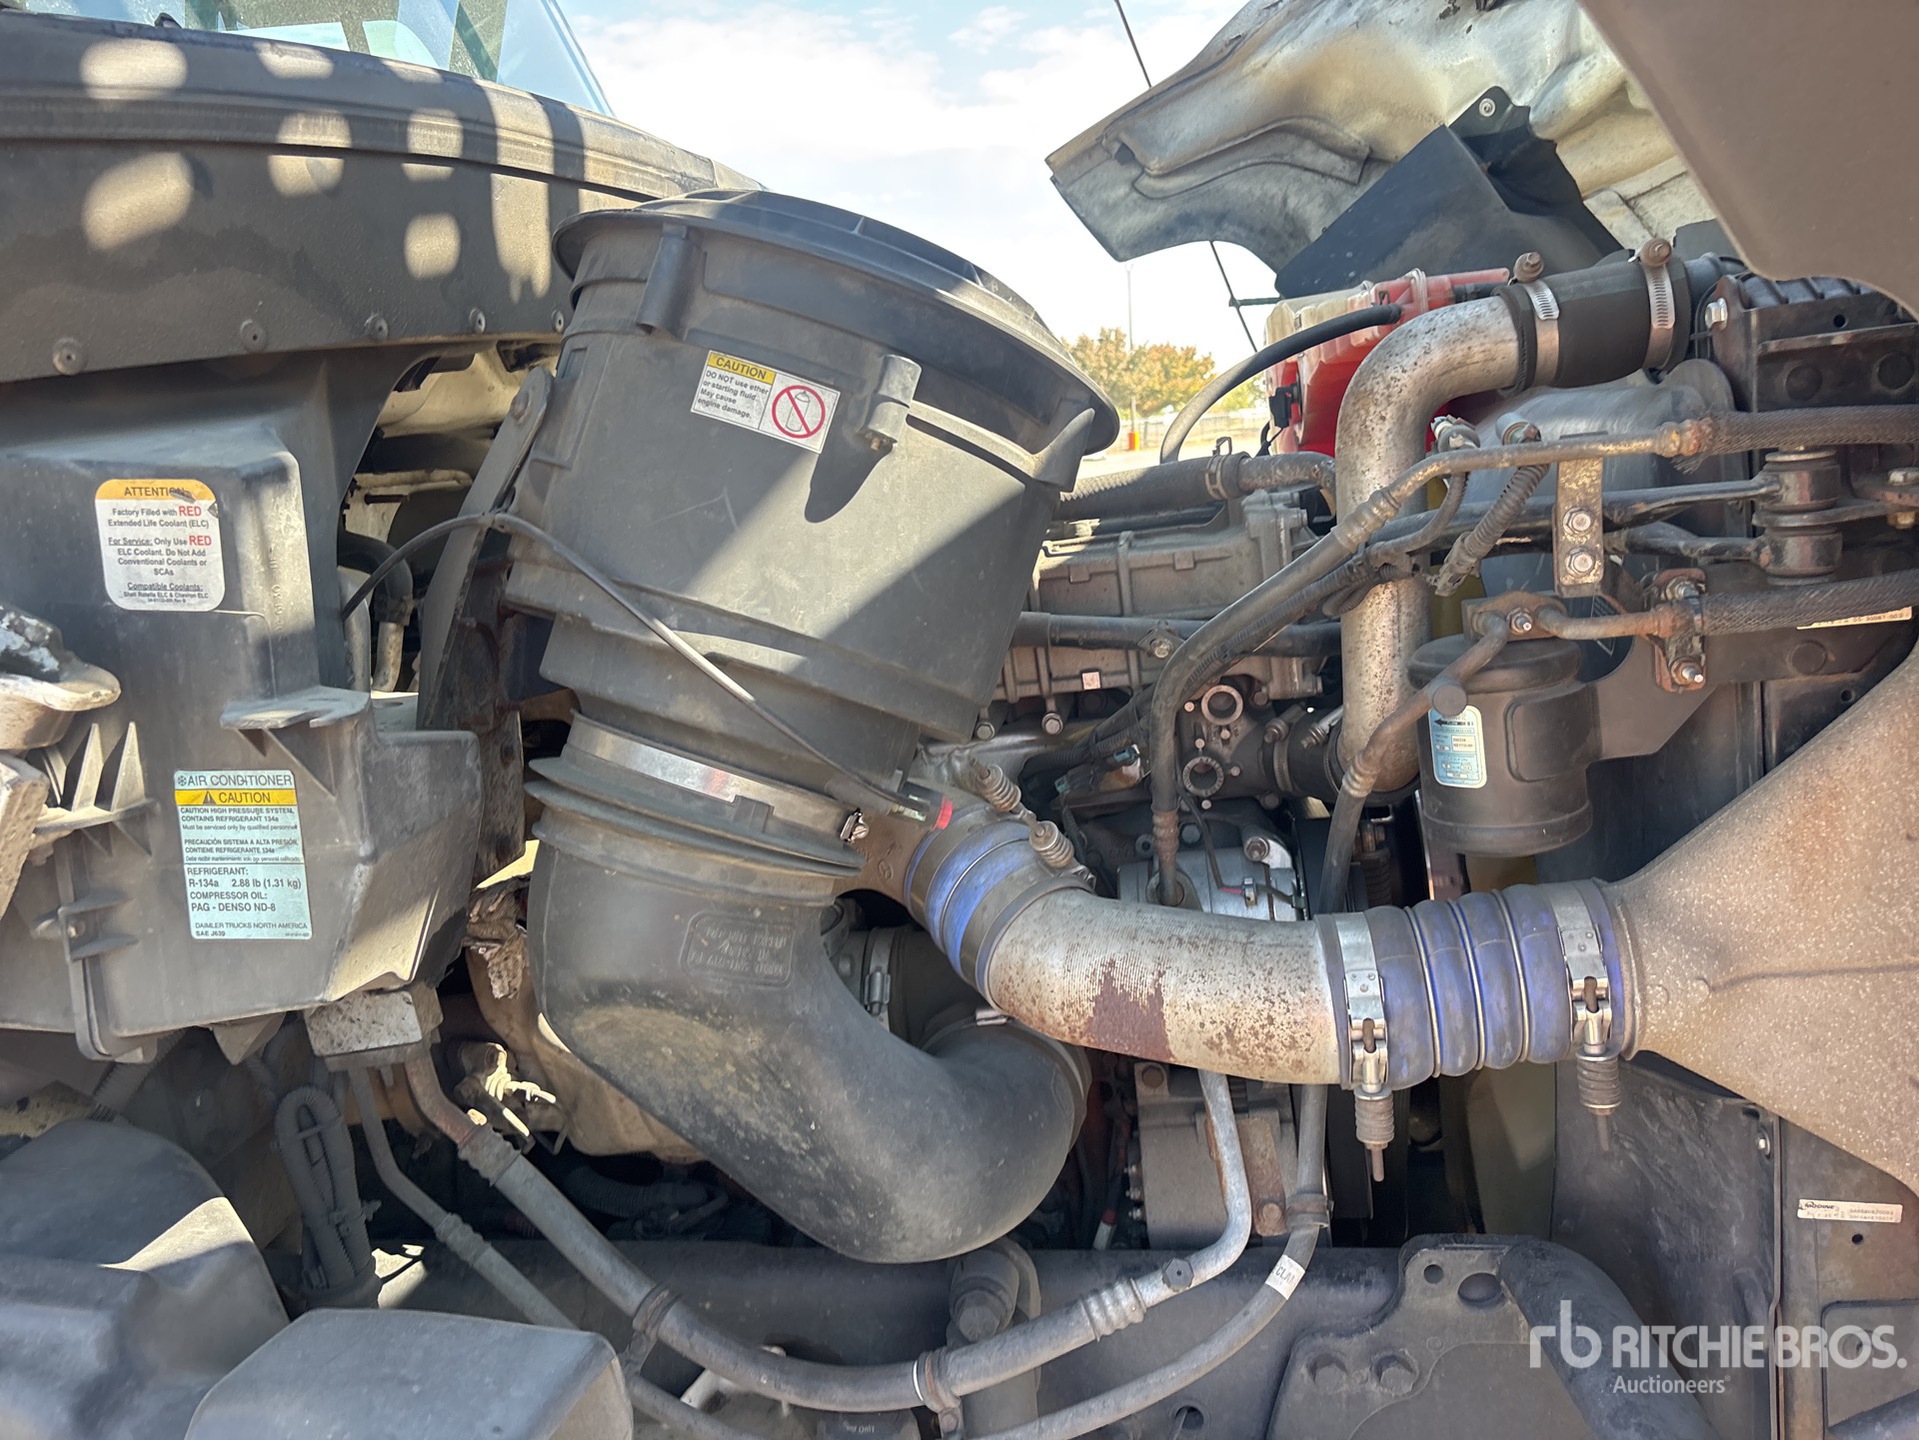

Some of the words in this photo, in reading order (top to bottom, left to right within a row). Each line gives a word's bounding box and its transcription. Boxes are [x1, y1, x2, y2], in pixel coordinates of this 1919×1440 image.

[716, 357, 767, 380] CAUTION
[718, 374, 734, 384] NOT
[735, 380, 748, 388] use
[749, 383, 768, 394] ether
[701, 388, 714, 399] May
[716, 394, 736, 404] cause
[712, 382, 738, 397] starting
[740, 391, 757, 400] fluid.
[698, 398, 720, 410] engine
[722, 405, 752, 419] damage.
[113, 509, 139, 517] Factory
[179, 506, 202, 516] RED
[189, 520, 209, 528] (ELC)
[123, 538, 153, 546] Service:
[154, 538, 171, 546] Only
[189, 535, 212, 546] RED
[128, 582, 167, 591] Compatible
[169, 584, 203, 592] Coolants:
[188, 775, 207, 786] AIR
[210, 775, 292, 786] CONDITIONER
[219, 792, 271, 803] CAUTION
[189, 879, 219, 887] R-134a
[264, 879, 284, 888] (1.31
[288, 880, 301, 889] kg)
